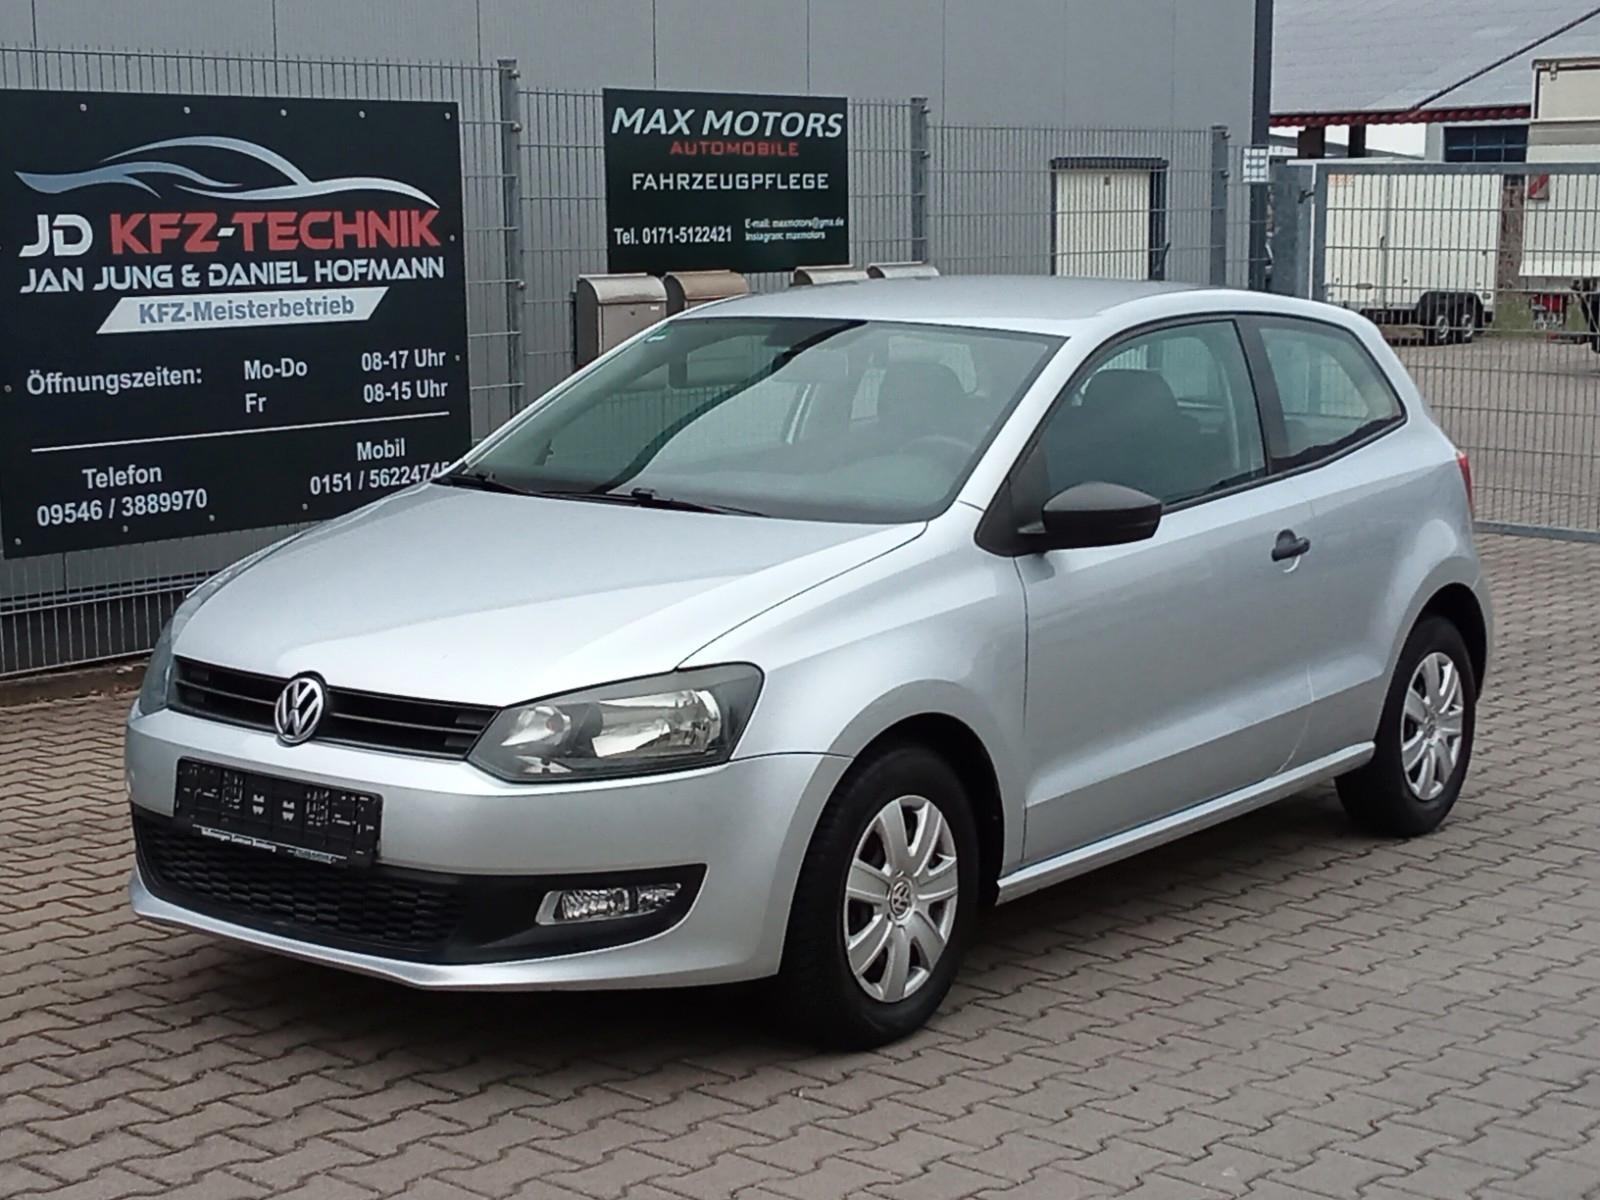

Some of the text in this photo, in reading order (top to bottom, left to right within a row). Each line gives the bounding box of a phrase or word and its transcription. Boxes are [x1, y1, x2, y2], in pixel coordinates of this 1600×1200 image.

[611, 107, 844, 137] MAX MOTORS
[670, 141, 799, 156] AUTOMOBILE
[632, 173, 829, 190] FAHRZEUGPFLEGE
[19, 210, 440, 257] JD KFZ-TECHNIK
[614, 226, 732, 244] Tel. 0171-5122421
[19, 257, 444, 293] JAN JUNG & DANIEL HOFMANN
[139, 294, 355, 324] KFZ-Meisterbetrieb
[26, 348, 446, 395] Öffnungszeiten: Mo-Do 08-17 Uhr
[245, 380, 448, 413] Fr 08-15 Uhr
[356, 437, 406, 461] Mobil
[82, 465, 163, 490] Telefon
[310, 472, 352, 495] 0151
[37, 488, 207, 527] 09546 / 3889970
